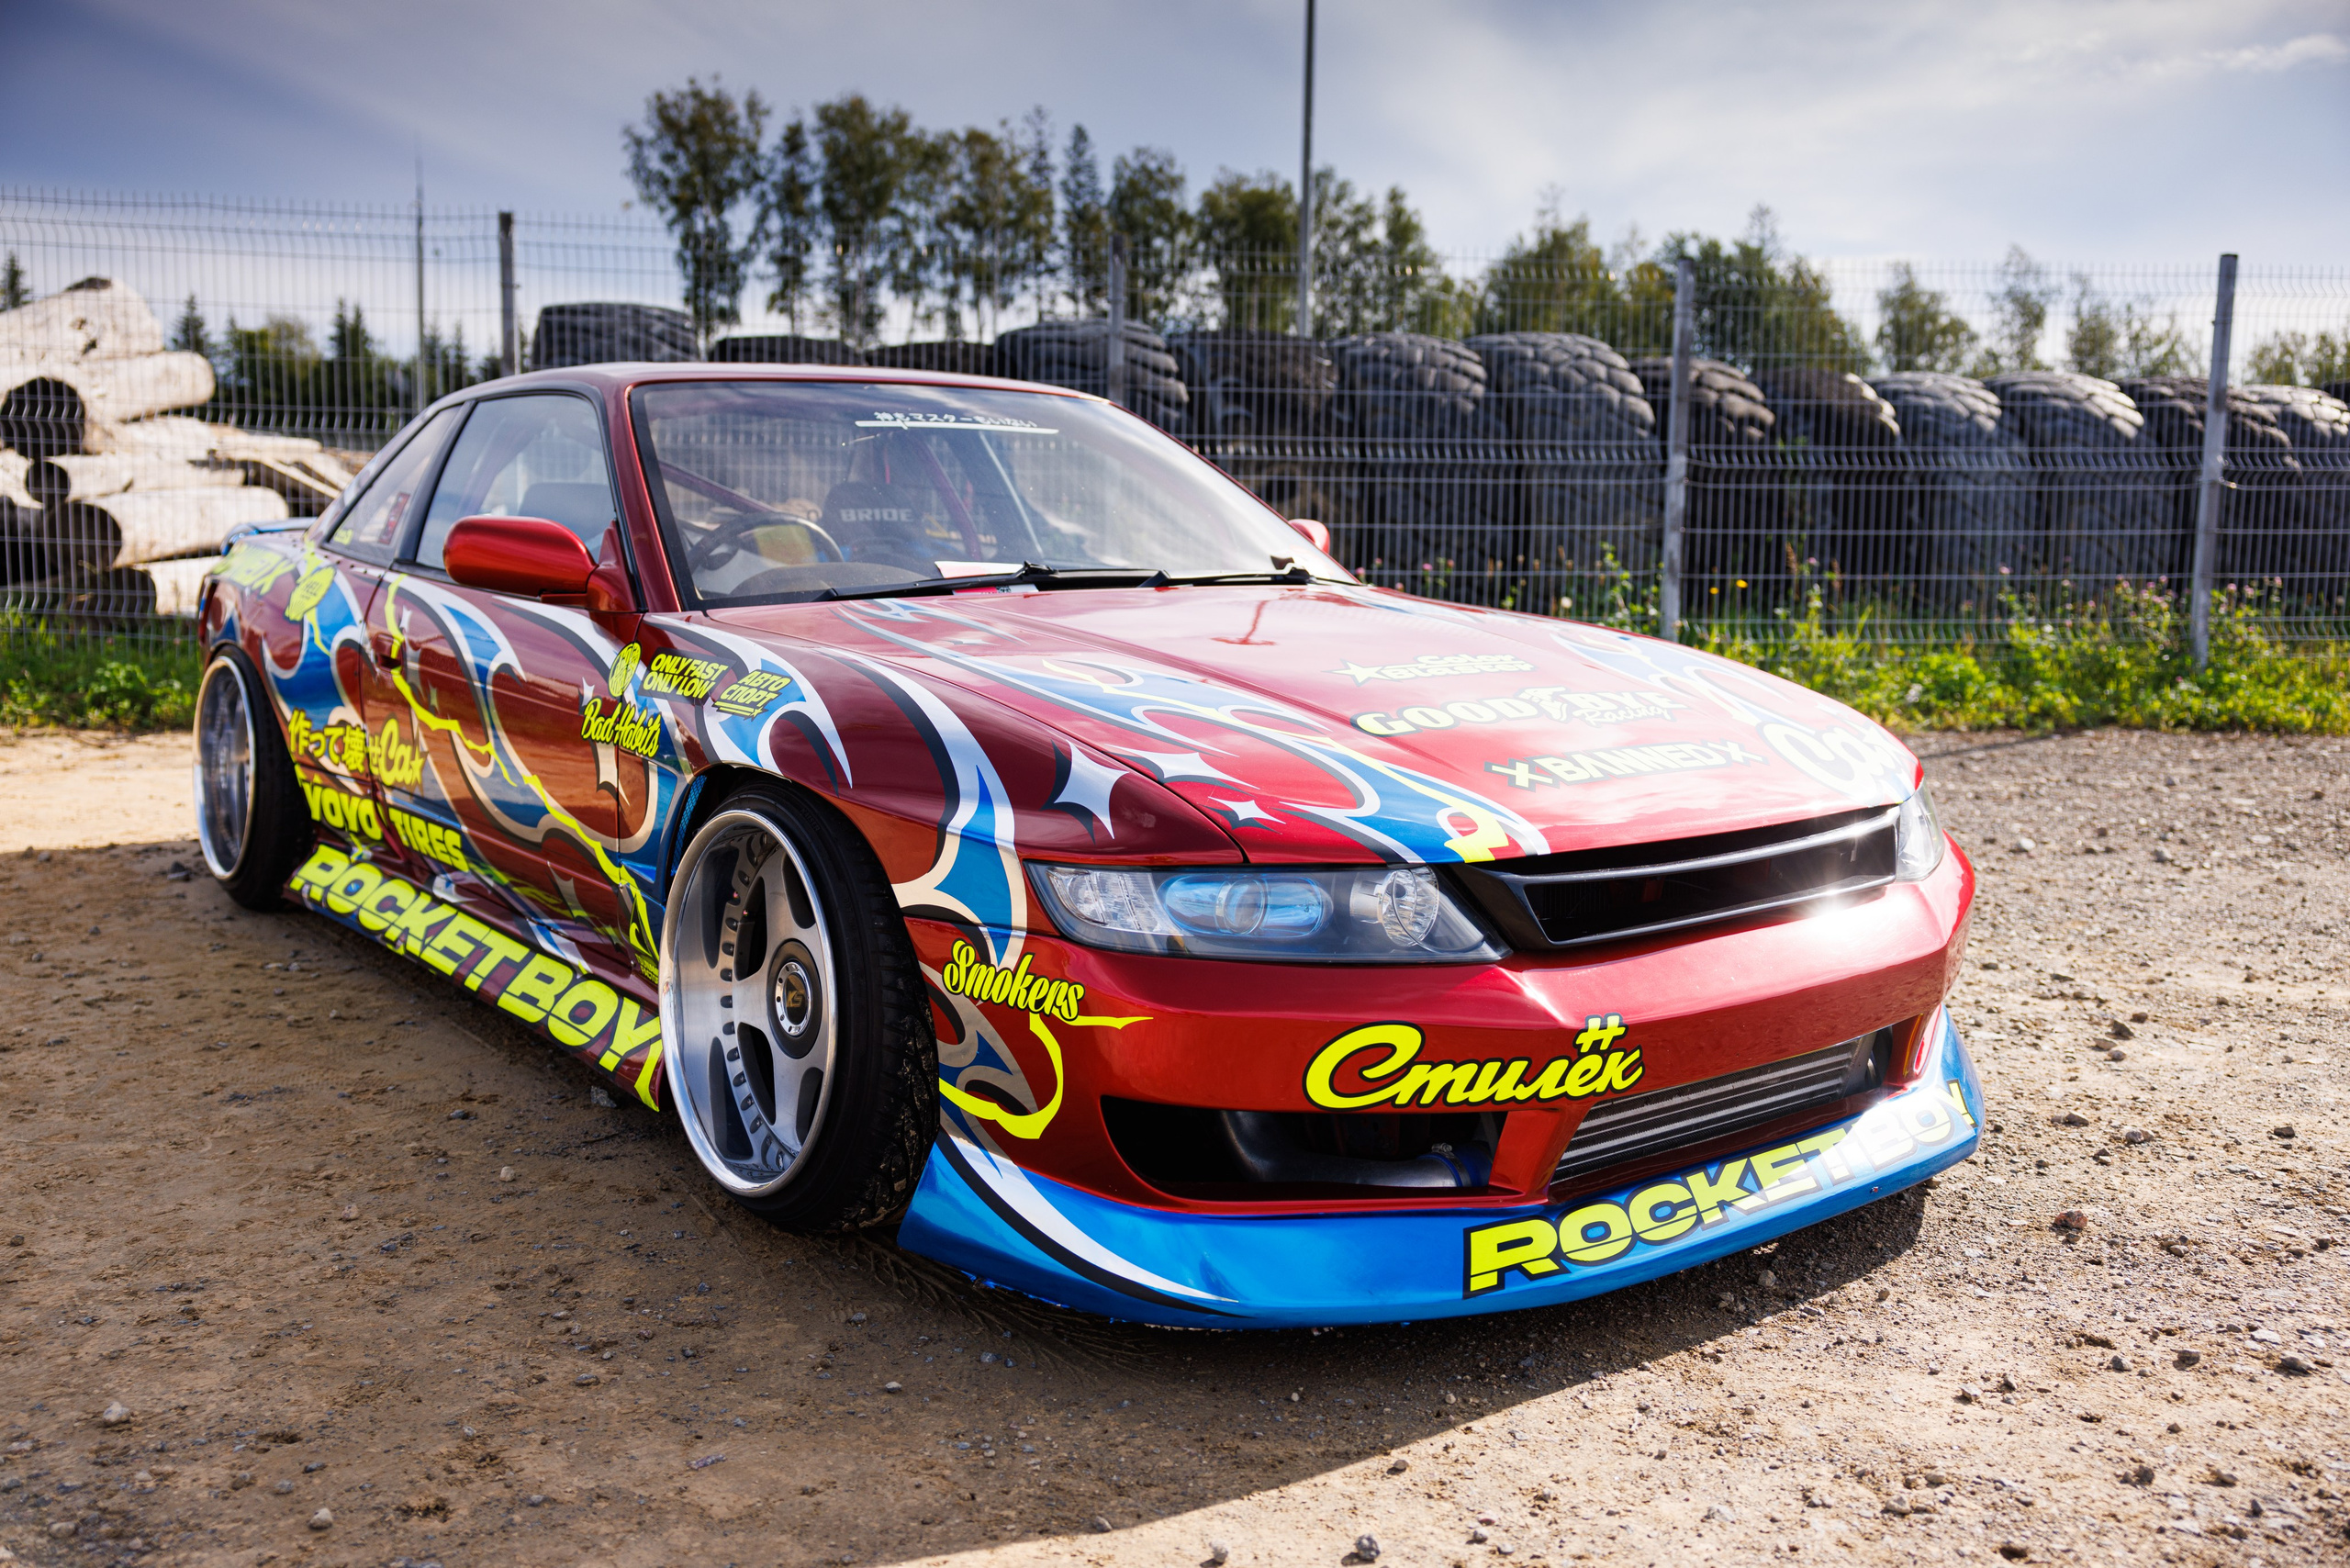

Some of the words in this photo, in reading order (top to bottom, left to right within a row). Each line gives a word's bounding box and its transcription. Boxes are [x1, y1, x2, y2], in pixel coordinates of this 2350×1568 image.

[840, 508, 913, 522] BRIDE
[650, 653, 693, 675] ONLY
[683, 659, 729, 681] FAST
[1382, 662, 1535, 680] Blaster
[1416, 654, 1516, 665] Color
[643, 671, 684, 693] ONLY
[676, 677, 716, 699] LOW
[720, 685, 778, 708] СПОРТ
[740, 670, 790, 691] АВТО
[581, 698, 622, 743] Bad
[613, 702, 661, 757] Habits
[1356, 697, 1539, 735] GOOD
[1563, 691, 1687, 711] BYE
[1572, 706, 1671, 725] Racing
[288, 709, 381, 775] 作って壊せ
[1534, 744, 1727, 782] BANNED
[302, 782, 383, 840] YOYO
[388, 808, 469, 872] TIRES
[289, 844, 662, 1072] ROCKETBOY
[944, 938, 1085, 1021] Smokers
[1304, 1014, 1644, 1113] Стилёк
[1469, 1080, 1977, 1292] ROCKETBOY
